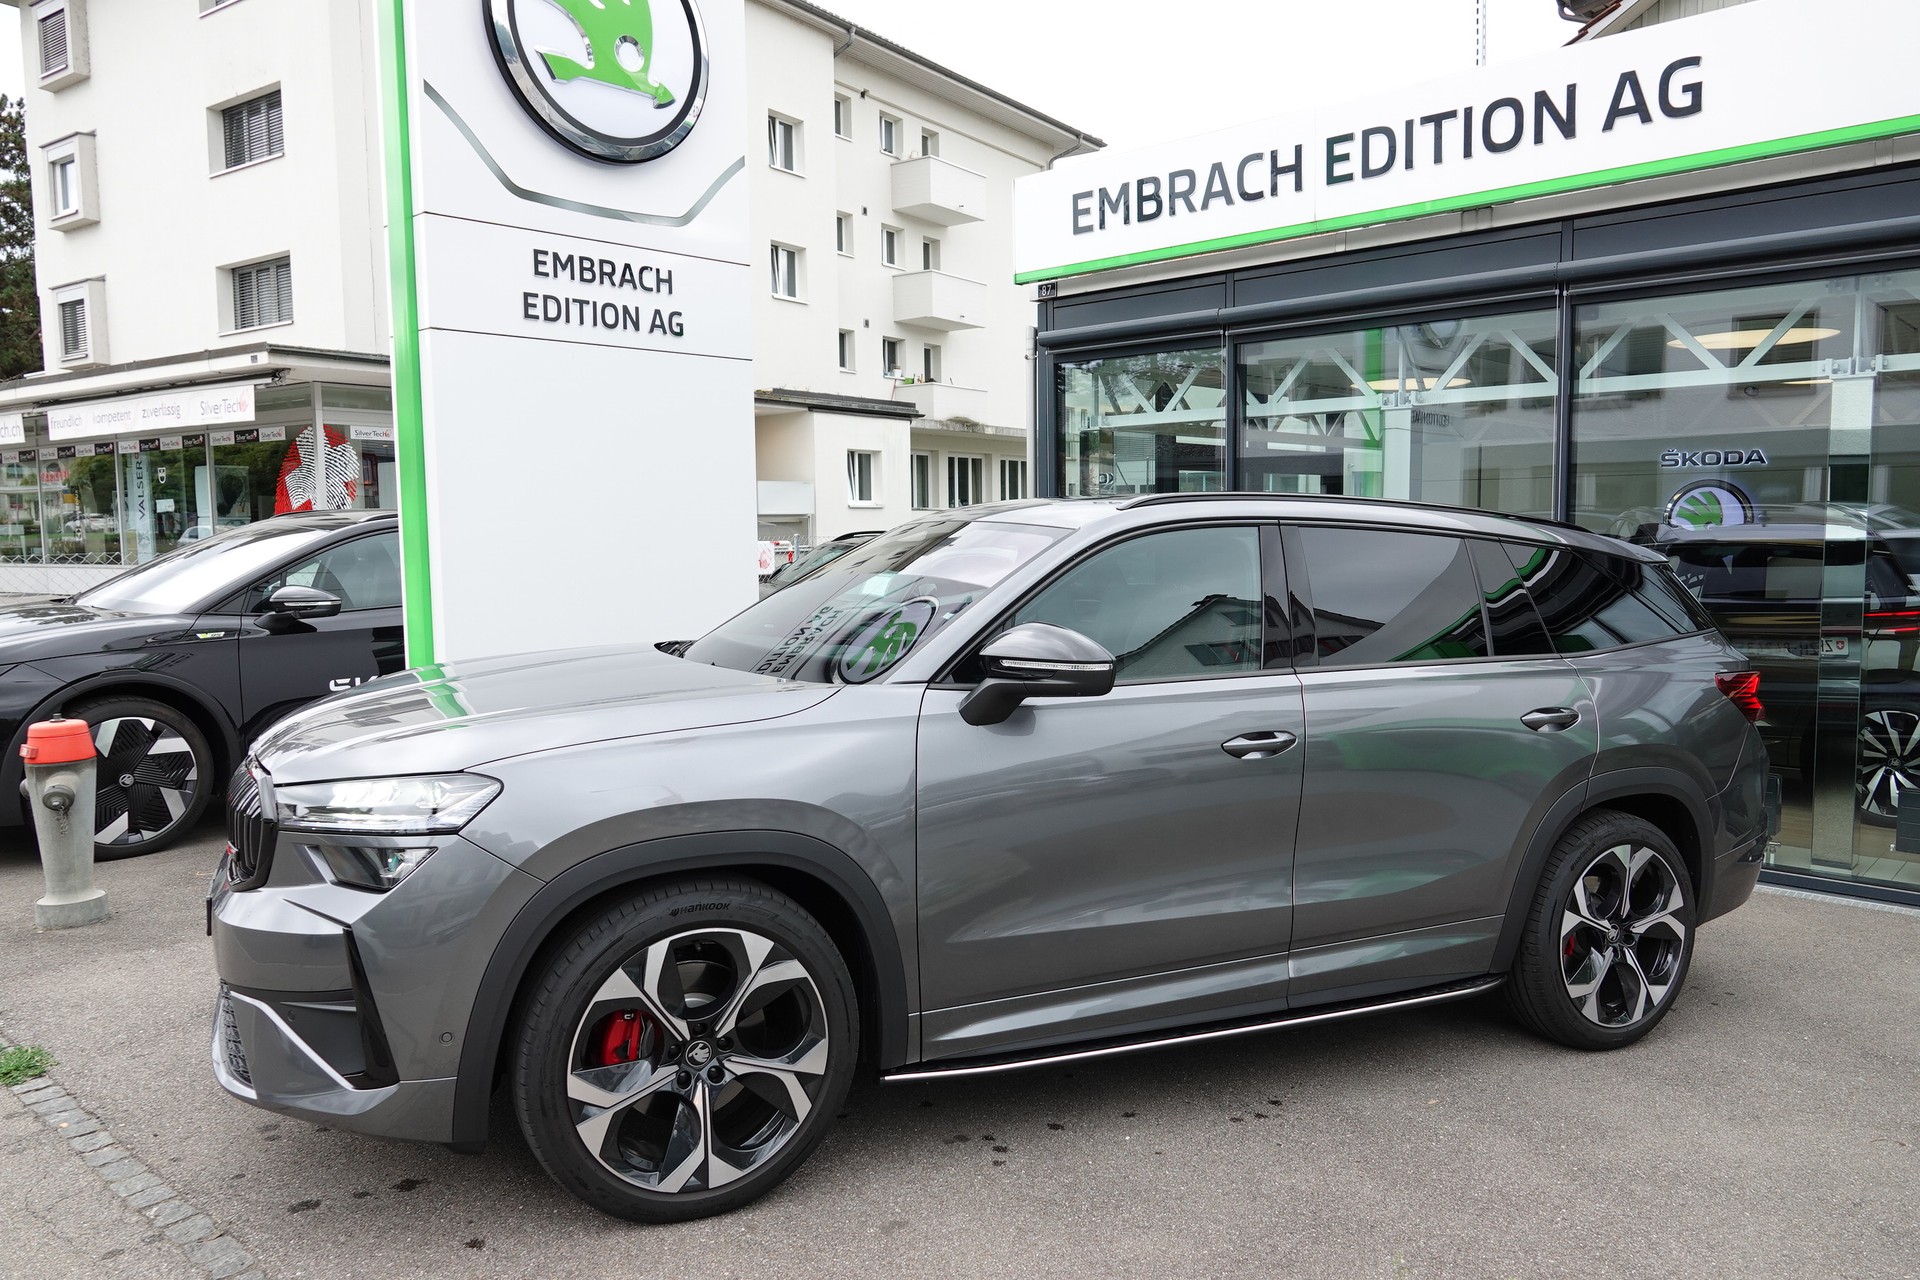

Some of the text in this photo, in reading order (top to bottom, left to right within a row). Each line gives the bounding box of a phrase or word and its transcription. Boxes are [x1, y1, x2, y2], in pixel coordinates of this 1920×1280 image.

[1072, 56, 1703, 236] EMBRACH EDITION AG
[533, 249, 673, 295] EMBRACH
[1041, 285, 1052, 296] 87
[523, 292, 684, 337] EDITION AG
[1661, 449, 1767, 467] ŠKODA
[136, 461, 146, 520] VALSER
